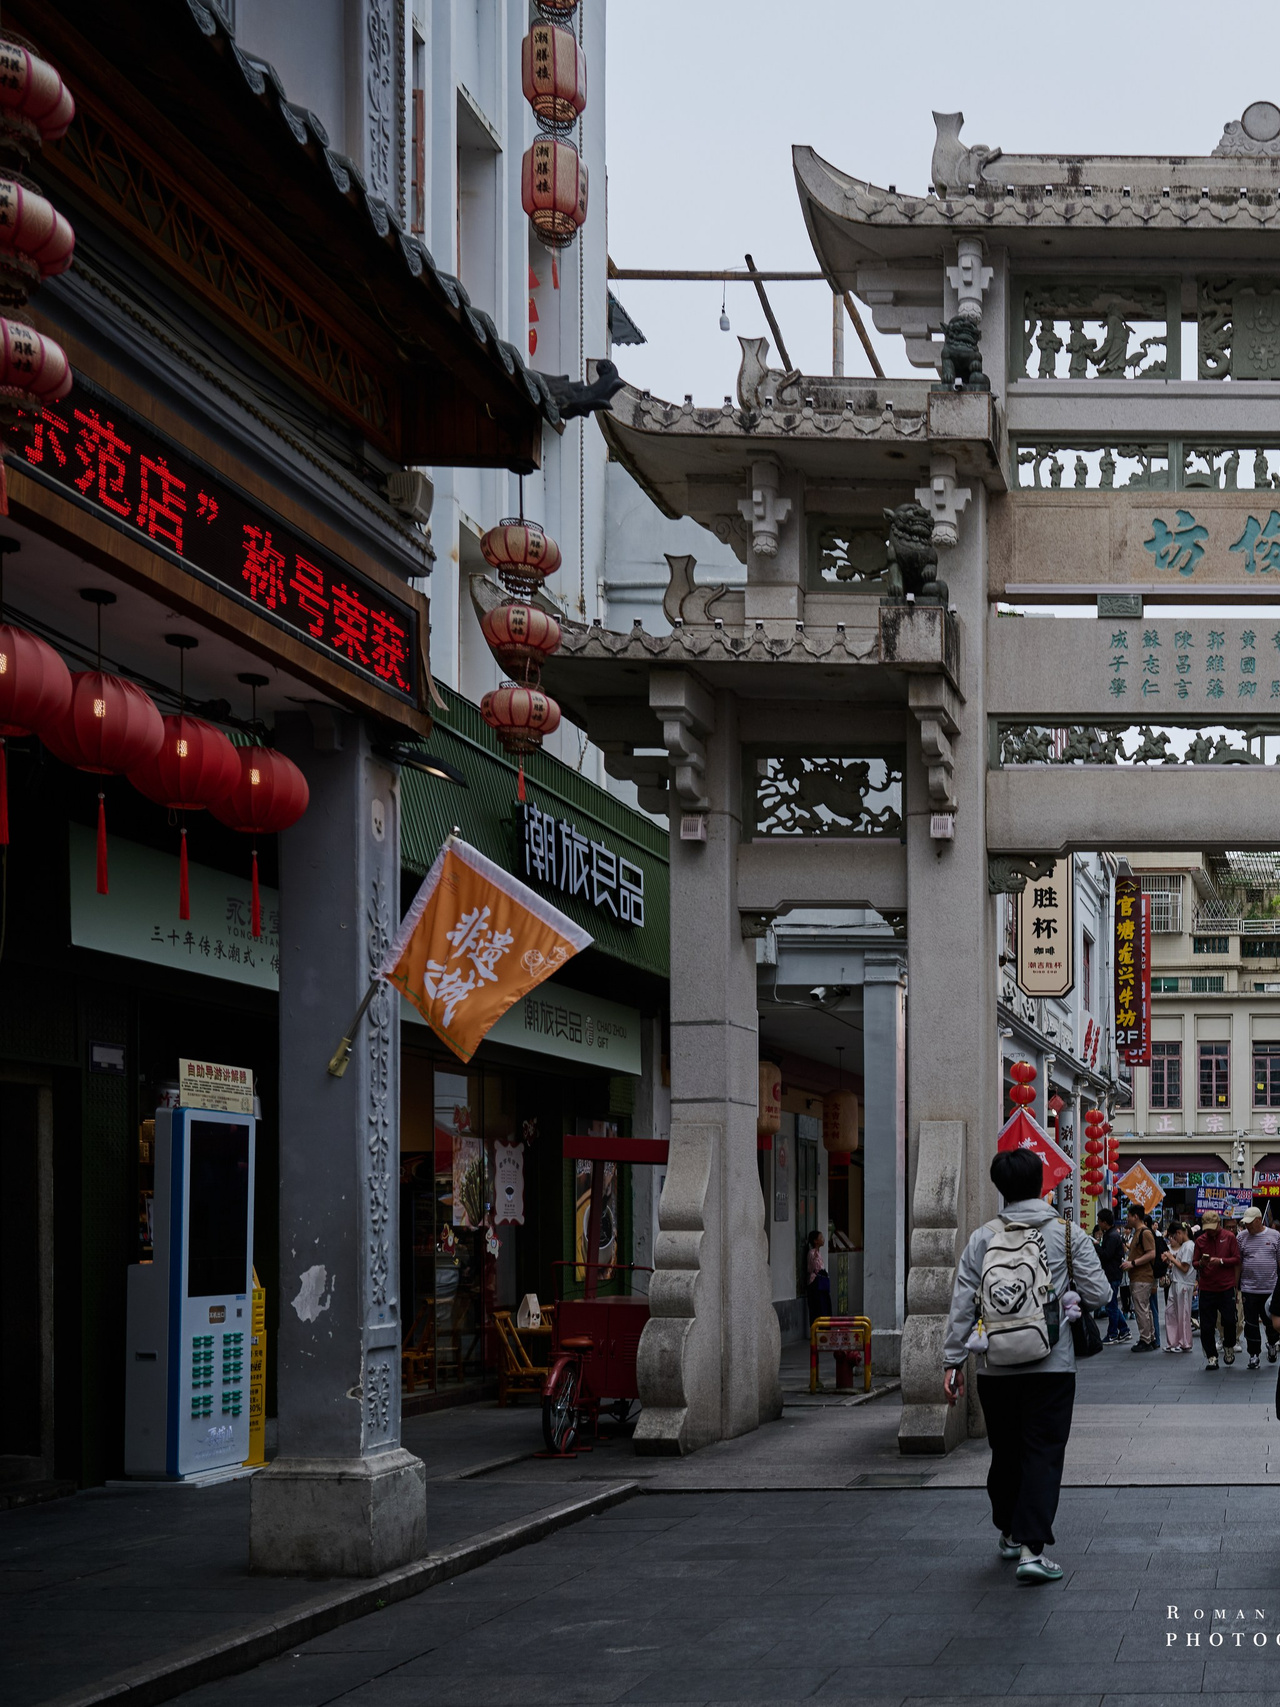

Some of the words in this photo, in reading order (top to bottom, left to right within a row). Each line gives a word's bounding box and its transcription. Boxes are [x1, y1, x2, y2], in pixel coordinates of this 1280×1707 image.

[524, 802, 645, 928] 潮旅良品
[1032, 867, 1059, 939] 胜杯
[524, 997, 583, 1044] 潮旅良品
[1116, 1029, 1139, 1045] 2F
